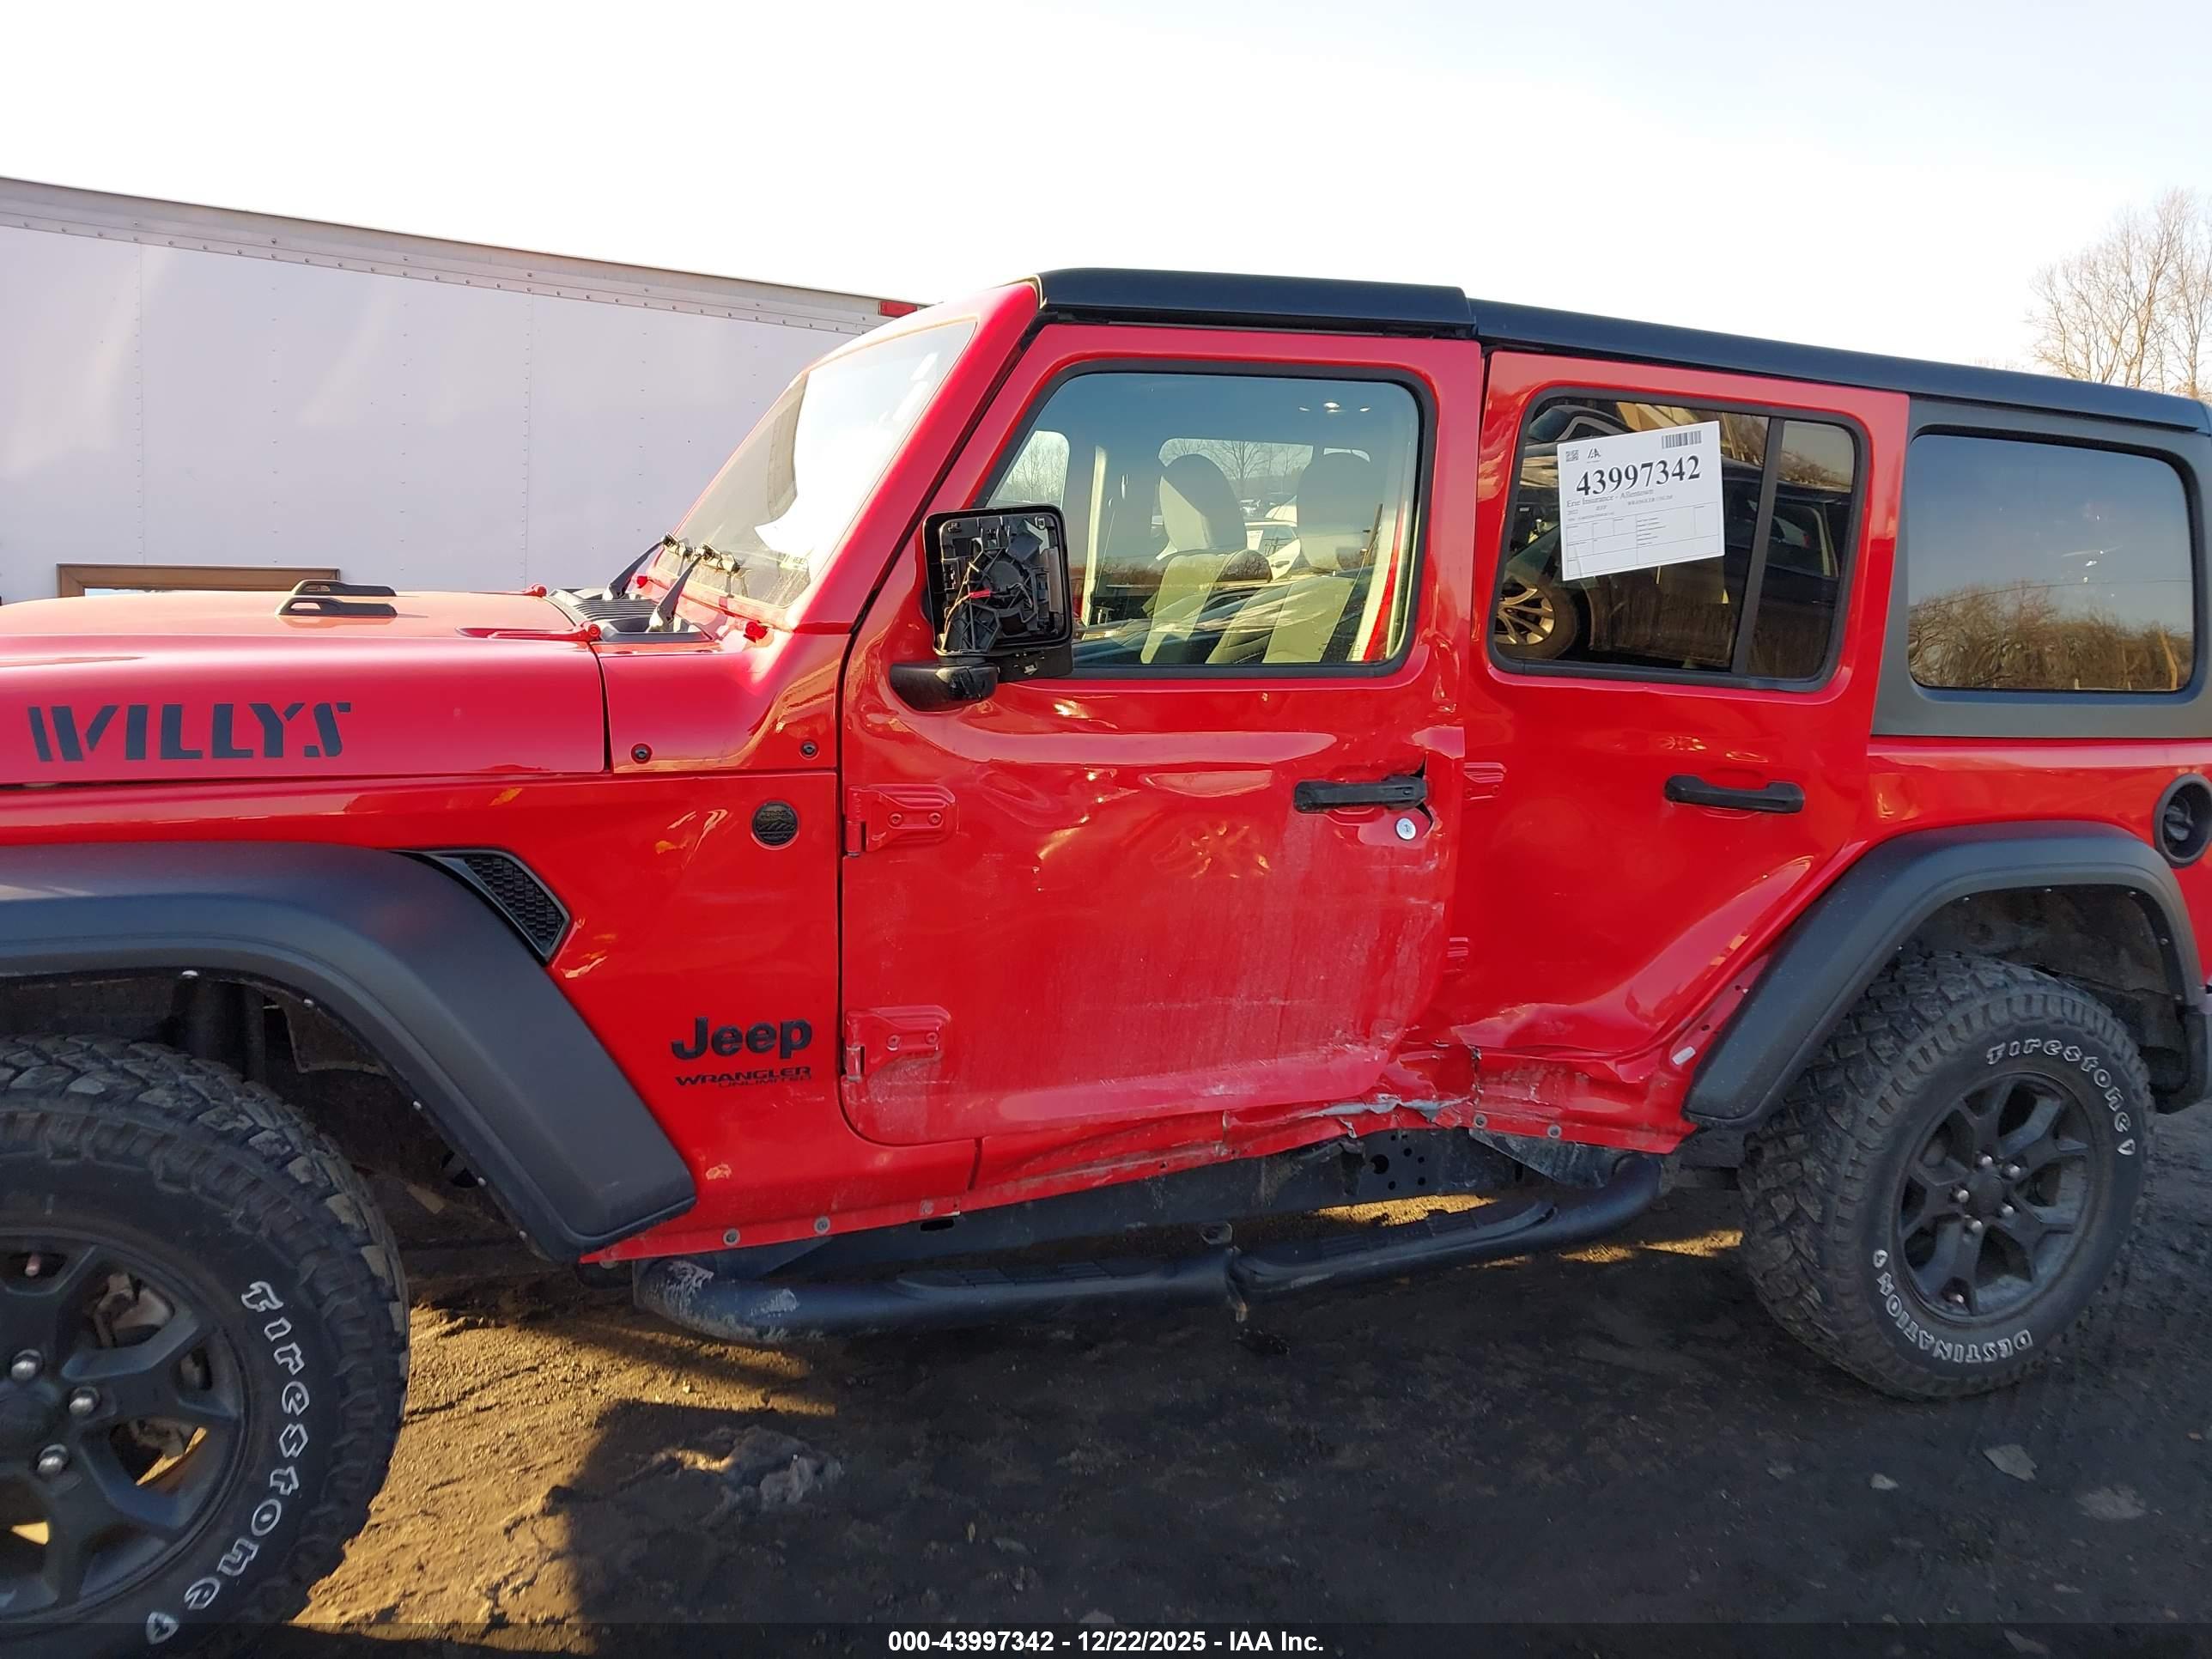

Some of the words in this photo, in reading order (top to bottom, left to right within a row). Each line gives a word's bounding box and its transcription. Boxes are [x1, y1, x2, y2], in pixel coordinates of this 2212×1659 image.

[1576, 455, 1702, 496] 43997342
[1582, 495, 1614, 505] Insurance
[27, 702, 351, 763] WILLYS
[672, 1017, 813, 1060] Jeep
[675, 1066, 811, 1086] WRANGLER
[1985, 1037, 2131, 1133] Firestone
[1876, 1272, 2034, 1364] DESTINATION
[184, 1280, 311, 1610] Firestone
